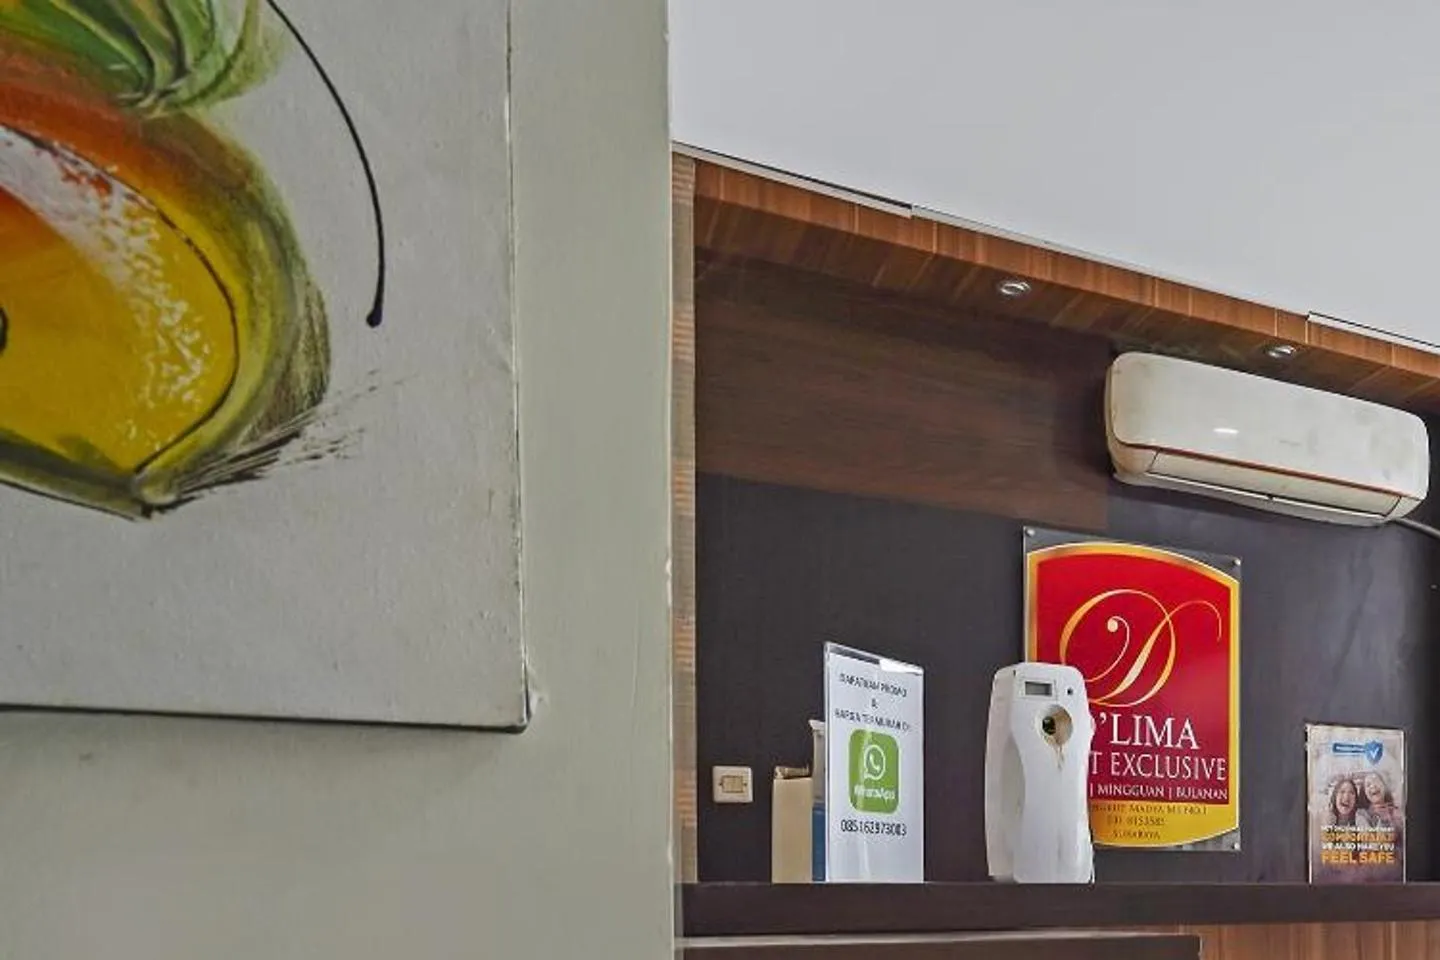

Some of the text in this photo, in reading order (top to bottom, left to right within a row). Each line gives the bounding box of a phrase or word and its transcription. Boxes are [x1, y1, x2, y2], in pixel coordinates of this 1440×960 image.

[1092, 713, 1200, 750] 'LIMA
[1111, 752, 1227, 781] EXCLUSIVE
[1098, 784, 1165, 799] MINGGUAN
[1176, 788, 1228, 801] BULANAN
[1321, 851, 1395, 864] FEEL SAFE
